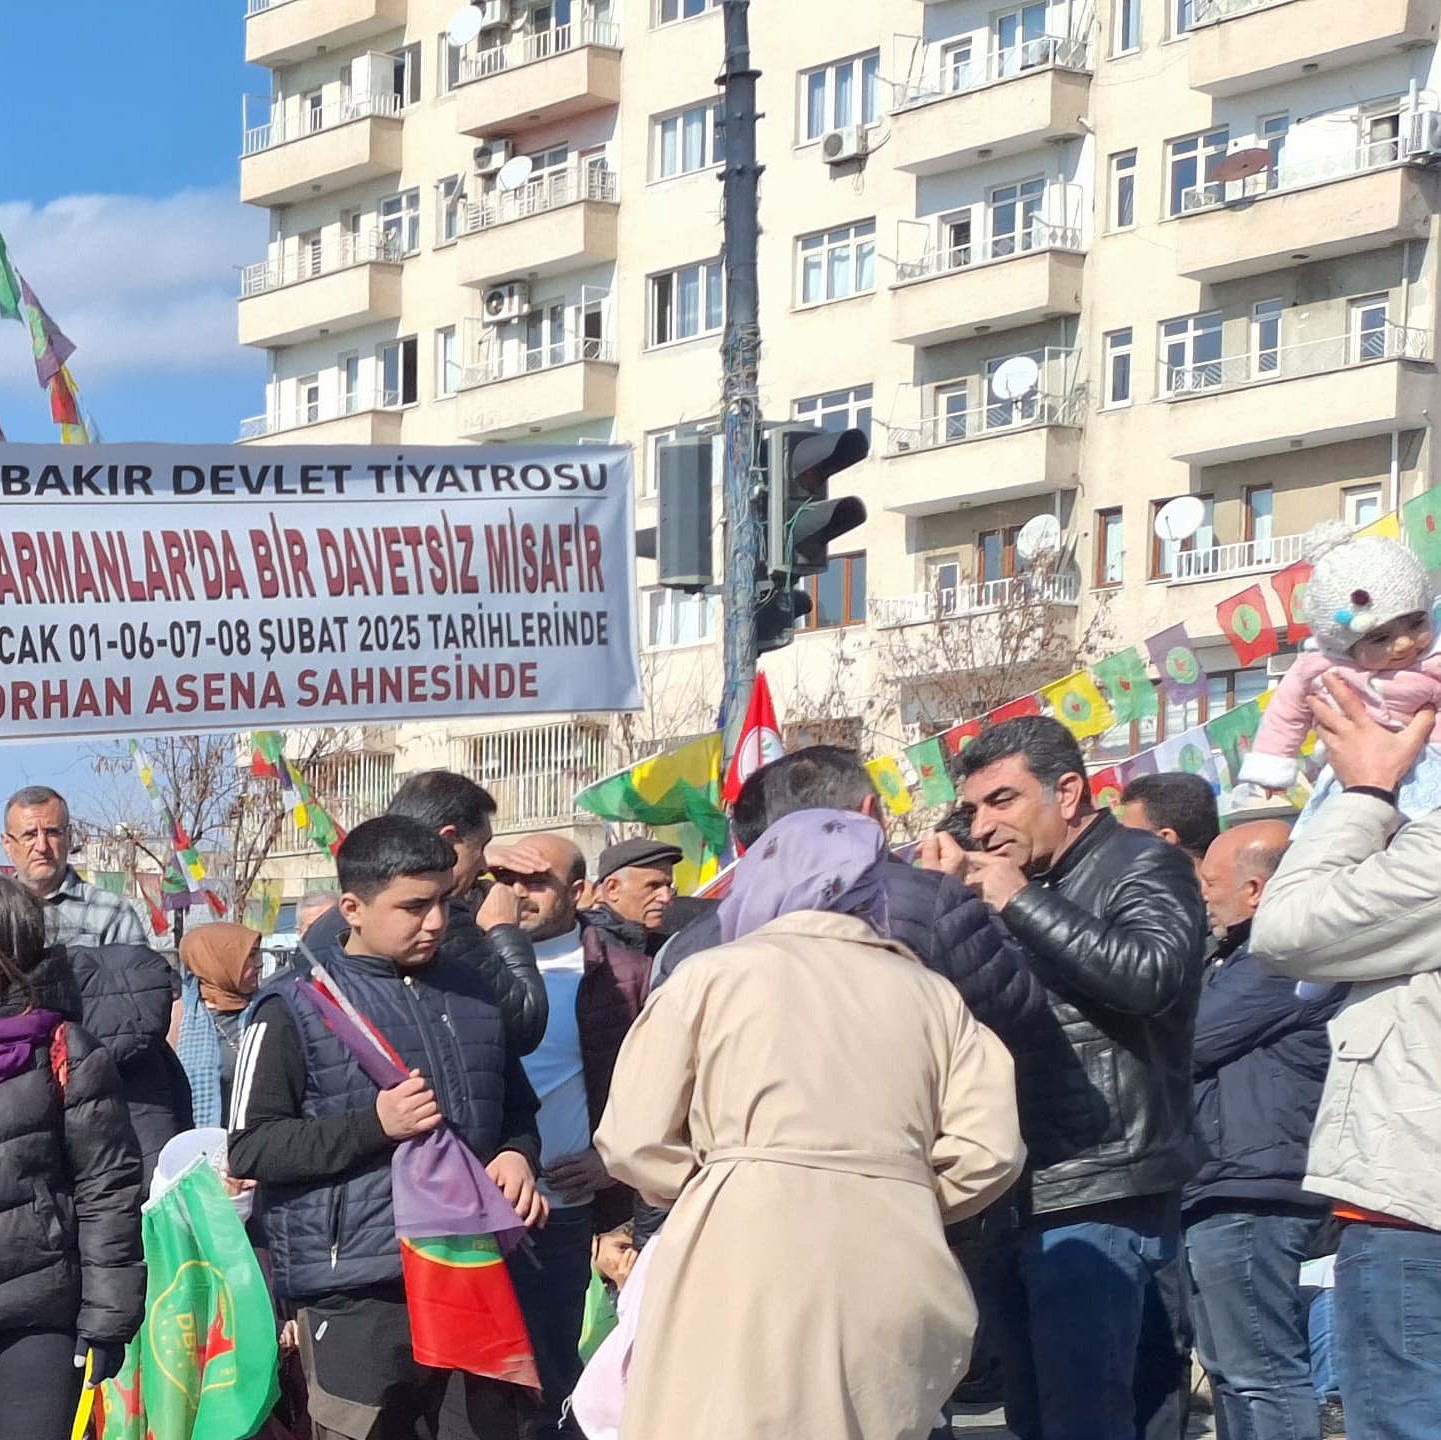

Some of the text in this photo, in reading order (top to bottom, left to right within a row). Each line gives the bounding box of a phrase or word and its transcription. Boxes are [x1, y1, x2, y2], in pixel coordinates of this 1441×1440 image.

[172, 464, 352, 496] DEVLET
[367, 455, 609, 494] TİYATROSU
[249, 511, 317, 600] BİR
[316, 509, 480, 598] DAVETSİZ
[483, 506, 605, 595] MİSAFİR
[69, 618, 252, 662] 01-06-07-08
[258, 615, 349, 662] ŞUBAT
[357, 613, 421, 652] 2025
[427, 601, 609, 650] TARİHLERİNDE
[144, 670, 286, 715] ASENA
[296, 653, 539, 708] SAHNESİNDE
